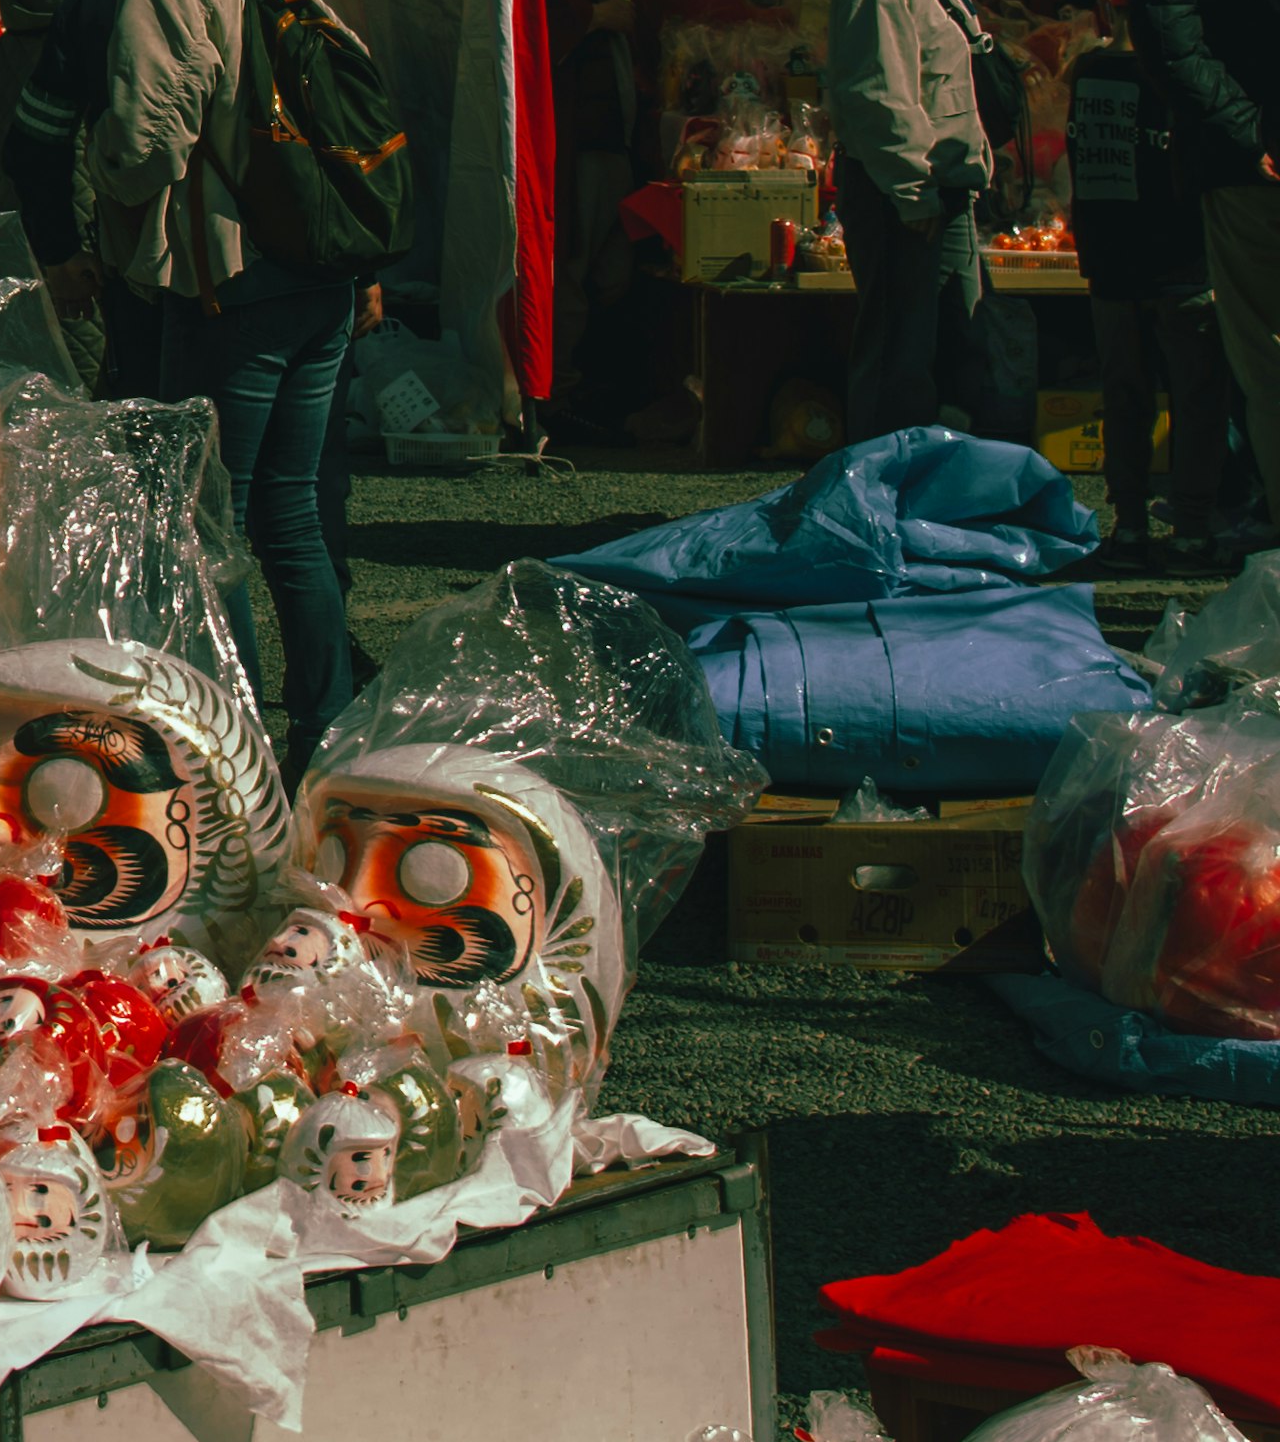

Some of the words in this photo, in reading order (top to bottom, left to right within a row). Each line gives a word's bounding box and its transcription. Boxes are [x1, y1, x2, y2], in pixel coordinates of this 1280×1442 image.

[1076, 97, 1115, 116] THIS
[1121, 100, 1137, 119] IS
[1077, 147, 1133, 167] SHINE
[772, 845, 823, 859] BANANAS
